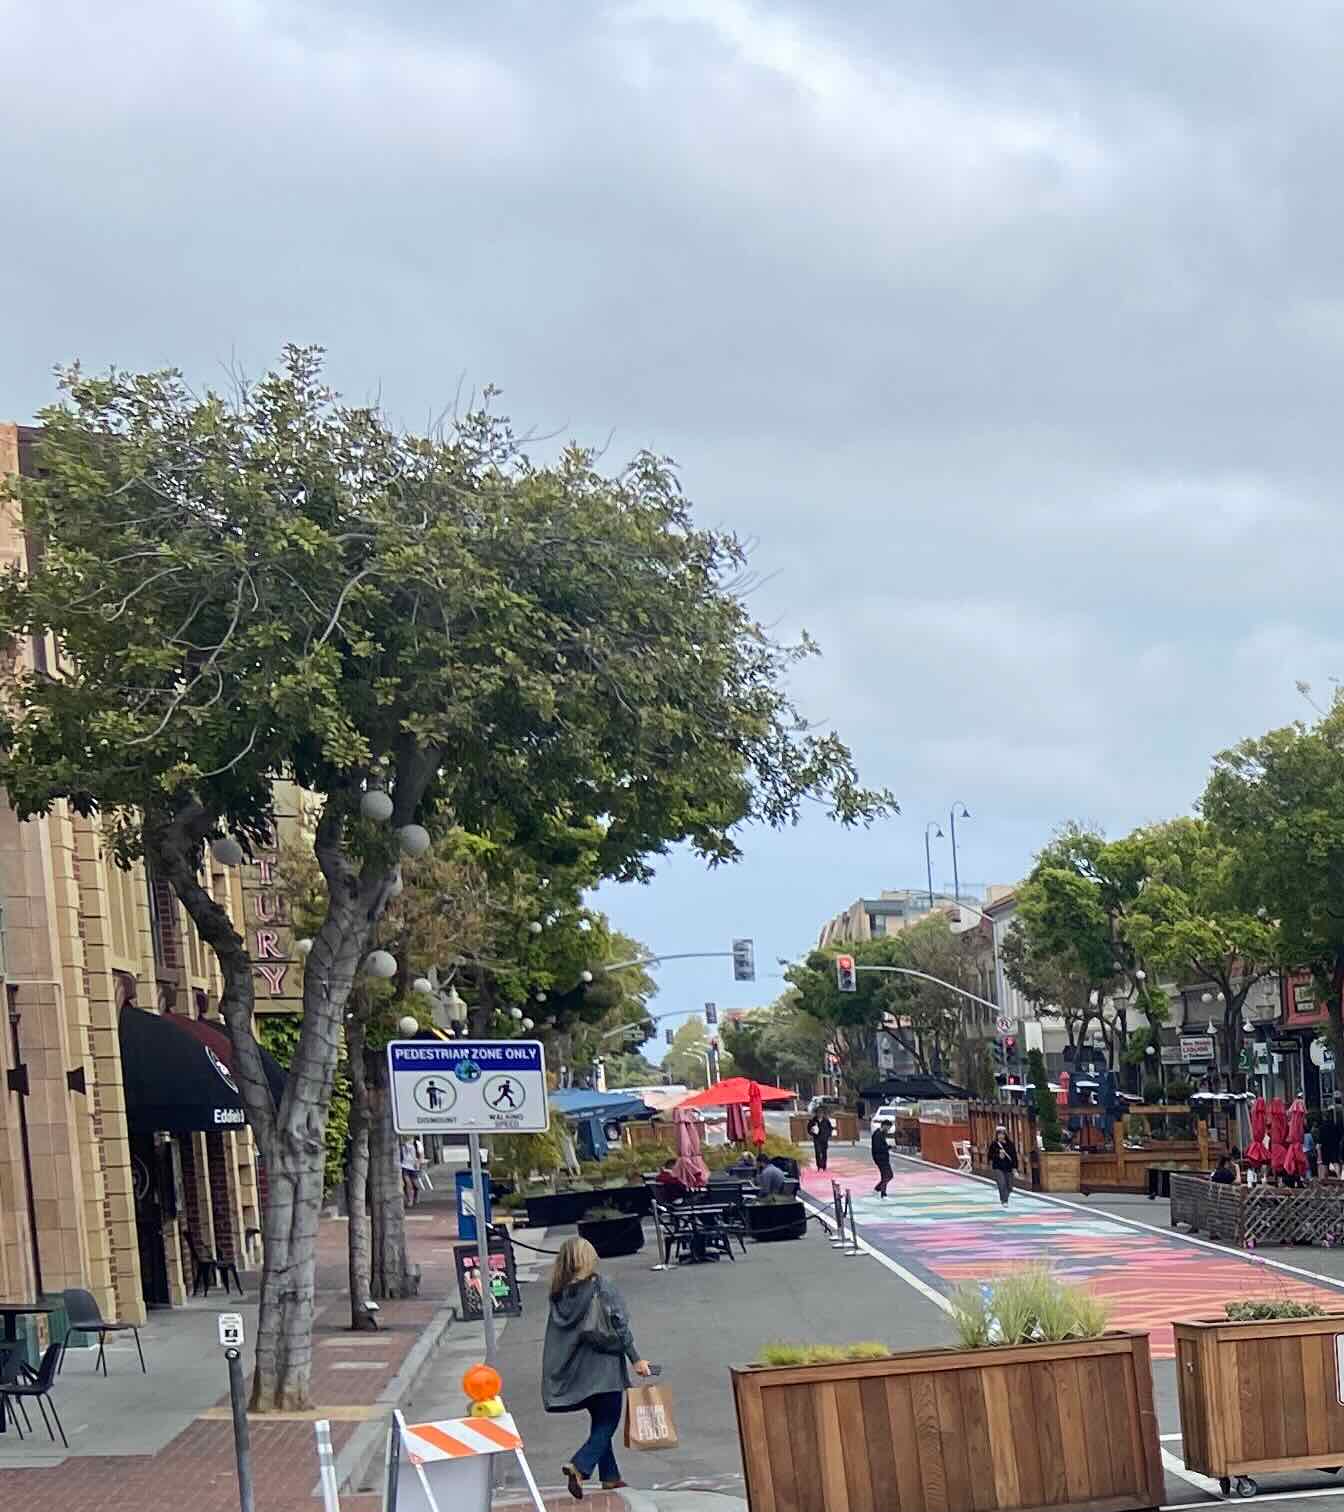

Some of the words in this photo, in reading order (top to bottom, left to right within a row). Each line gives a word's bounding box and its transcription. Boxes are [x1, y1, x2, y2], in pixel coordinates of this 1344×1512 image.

[396, 1048, 470, 1060] PEDESTRIAN
[472, 1048, 502, 1060] ZONE
[505, 1048, 537, 1060] ONLY
